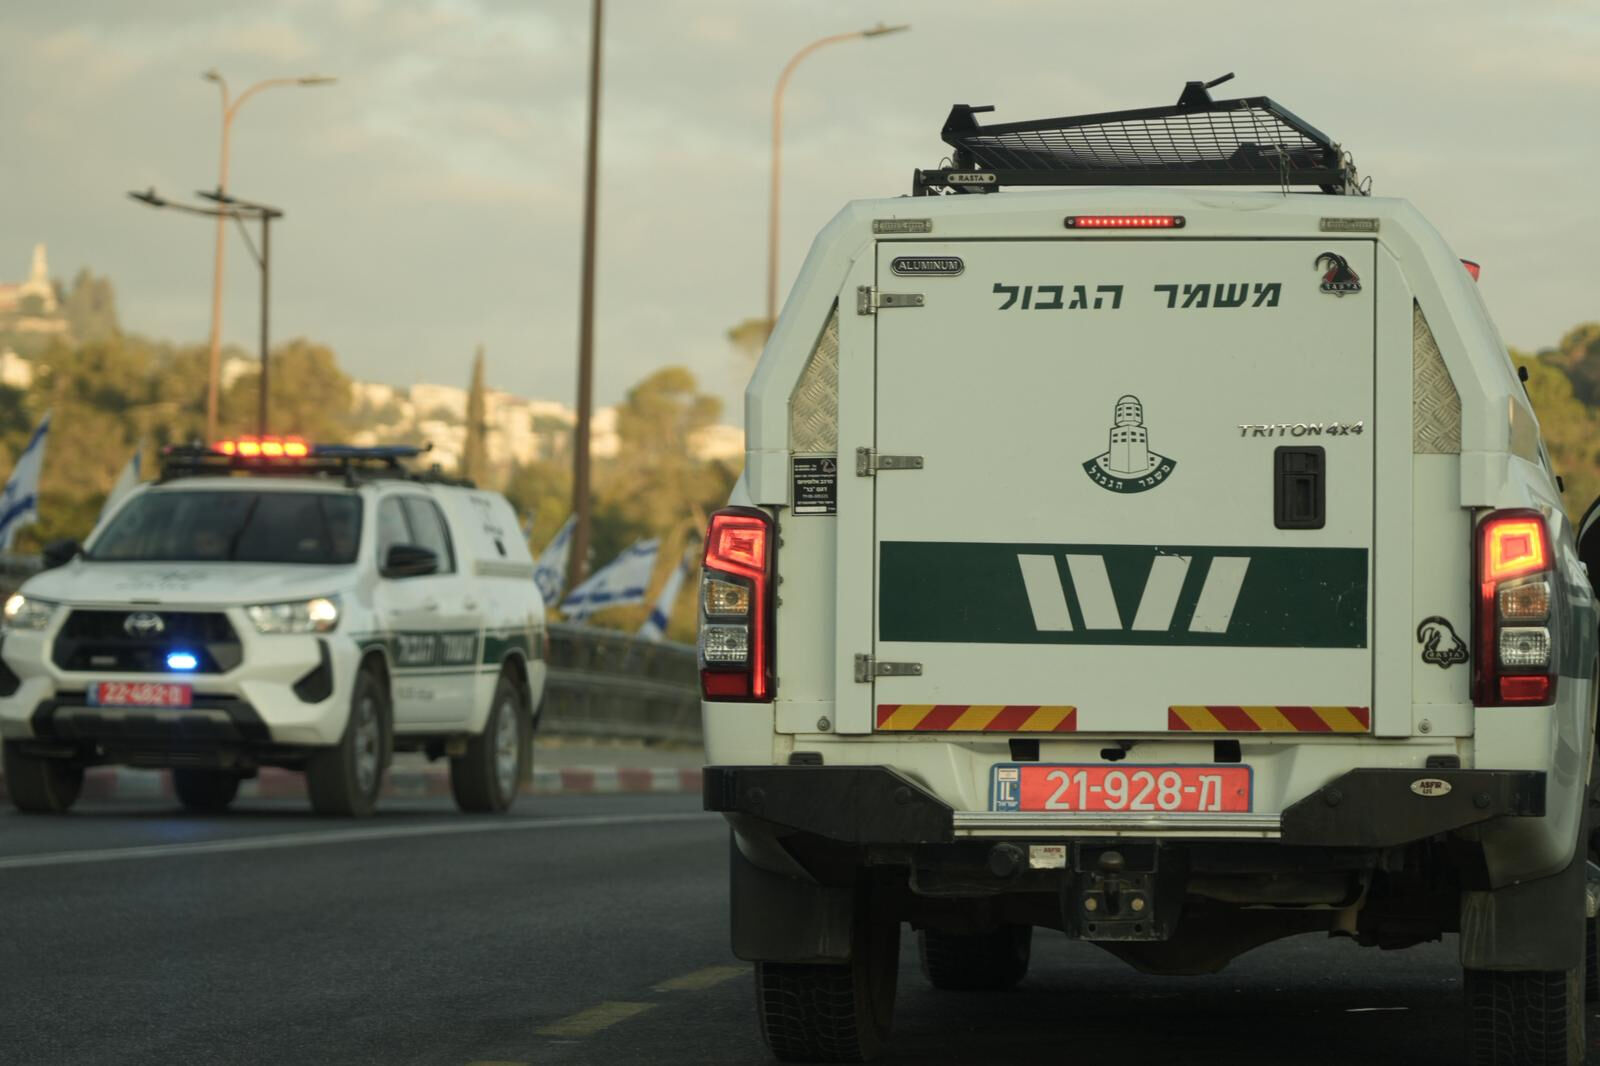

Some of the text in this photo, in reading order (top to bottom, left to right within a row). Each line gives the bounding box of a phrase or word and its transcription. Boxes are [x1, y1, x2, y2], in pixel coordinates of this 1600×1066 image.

[898, 261, 958, 270] ALUMINUM
[992, 283, 1281, 310] משמר הגבול
[1237, 421, 1364, 437] TRITON 4x4
[1088, 464, 1170, 489] משמר הגבול
[1044, 770, 1223, 811] 21-928-מ
